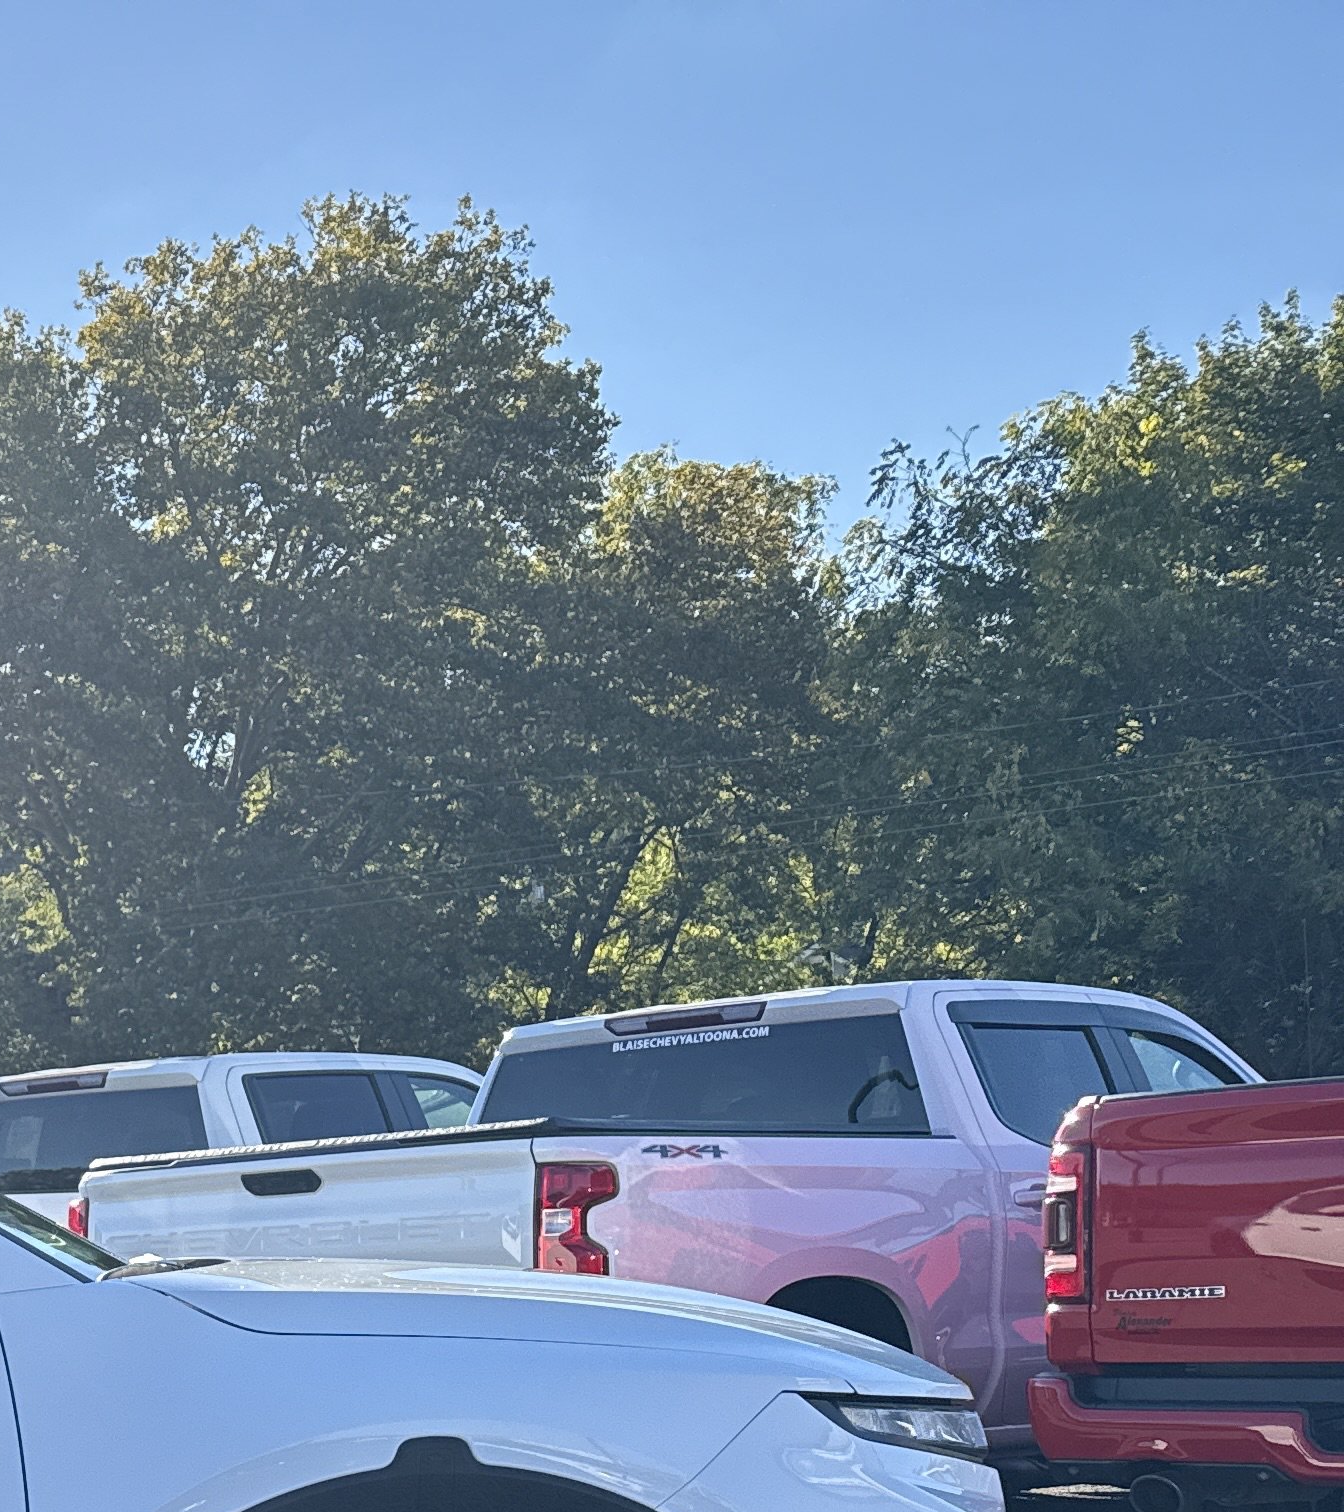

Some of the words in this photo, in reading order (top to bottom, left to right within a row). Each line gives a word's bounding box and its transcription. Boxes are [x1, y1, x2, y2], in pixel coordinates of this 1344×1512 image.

[612, 1026, 769, 1052] BLAISECHEVYALTOONA.COM
[641, 1144, 728, 1158] 4X4
[106, 1212, 491, 1257] CHEVROLET
[1106, 1286, 1225, 1301] LARAMIE
